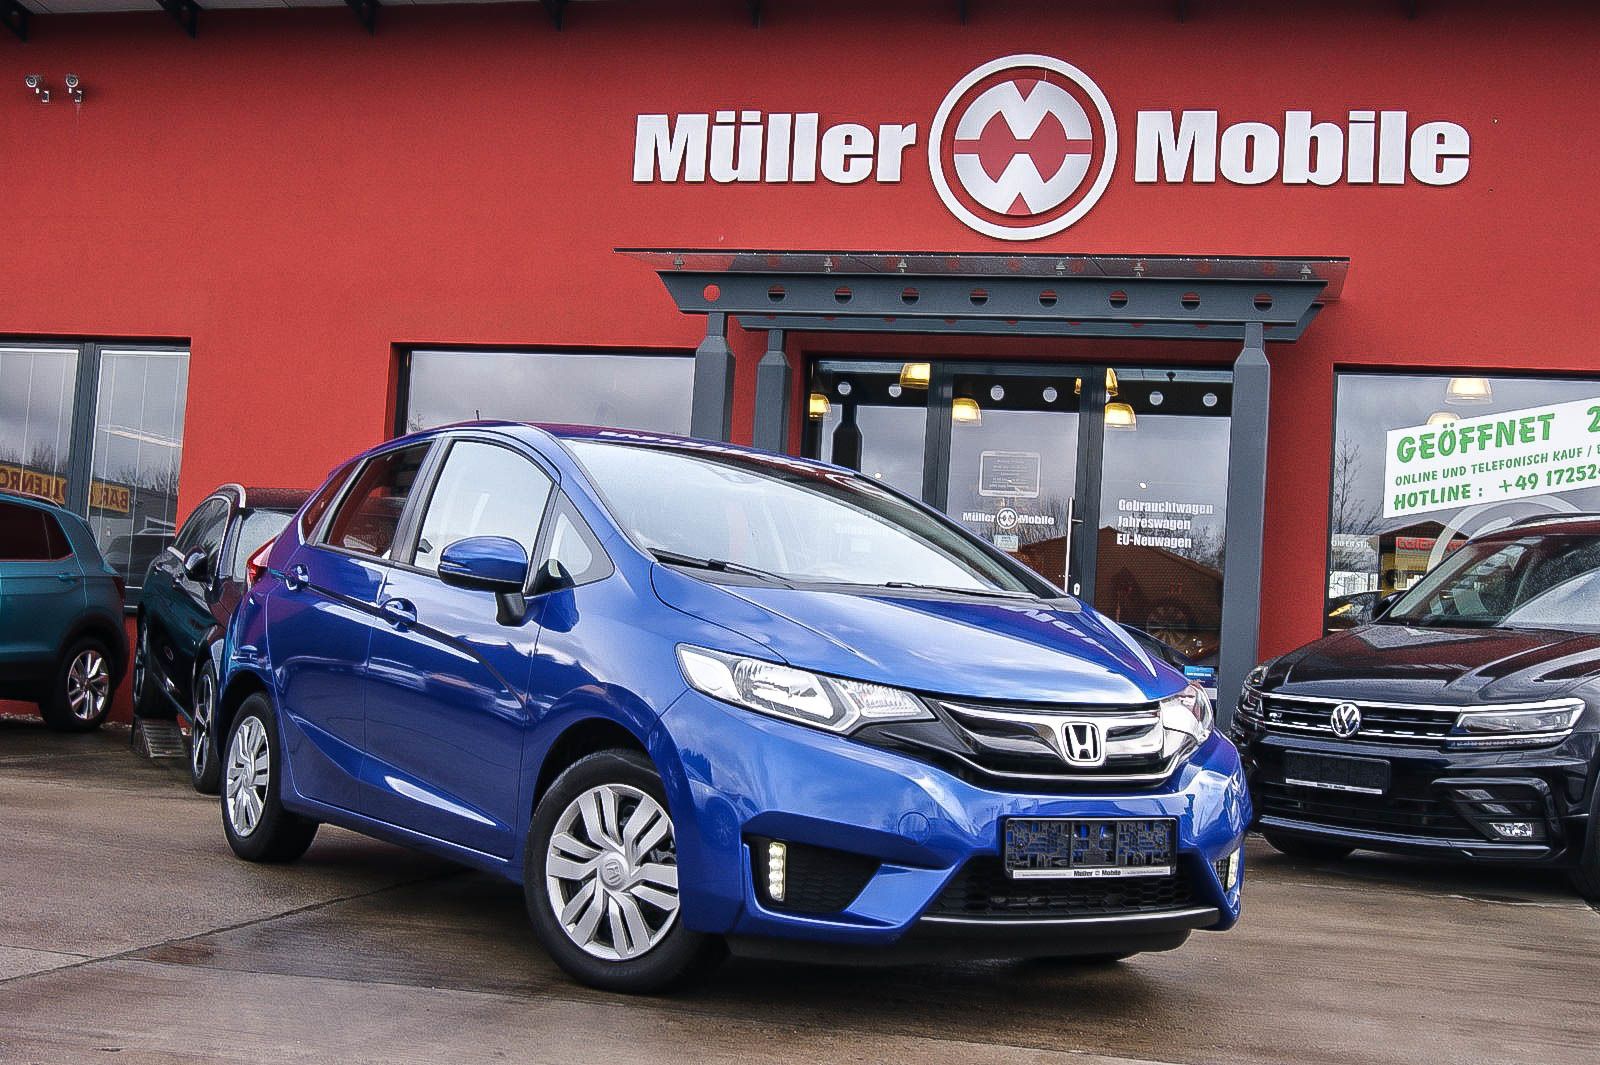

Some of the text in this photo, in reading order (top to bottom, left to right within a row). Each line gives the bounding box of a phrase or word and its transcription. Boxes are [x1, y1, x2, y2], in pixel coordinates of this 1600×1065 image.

[633, 110, 1470, 185] Müller Mobile
[1396, 413, 1555, 463] GEÖFFNET
[1395, 470, 1438, 486] ONLINE
[1442, 466, 1467, 479] UND
[1471, 452, 1549, 475] TELEFONISCH
[1552, 447, 1583, 461] KAUF
[1394, 483, 1471, 510] HOTLINE
[1499, 472, 1539, 493] +49
[1546, 463, 1600, 487] 17252
[962, 511, 1055, 525] Müller Mobile
[1118, 499, 1214, 515] Gebrauchtwagen
[1118, 516, 1191, 531] Jahreswagen
[1116, 533, 1192, 549] EU-Neuwagen
